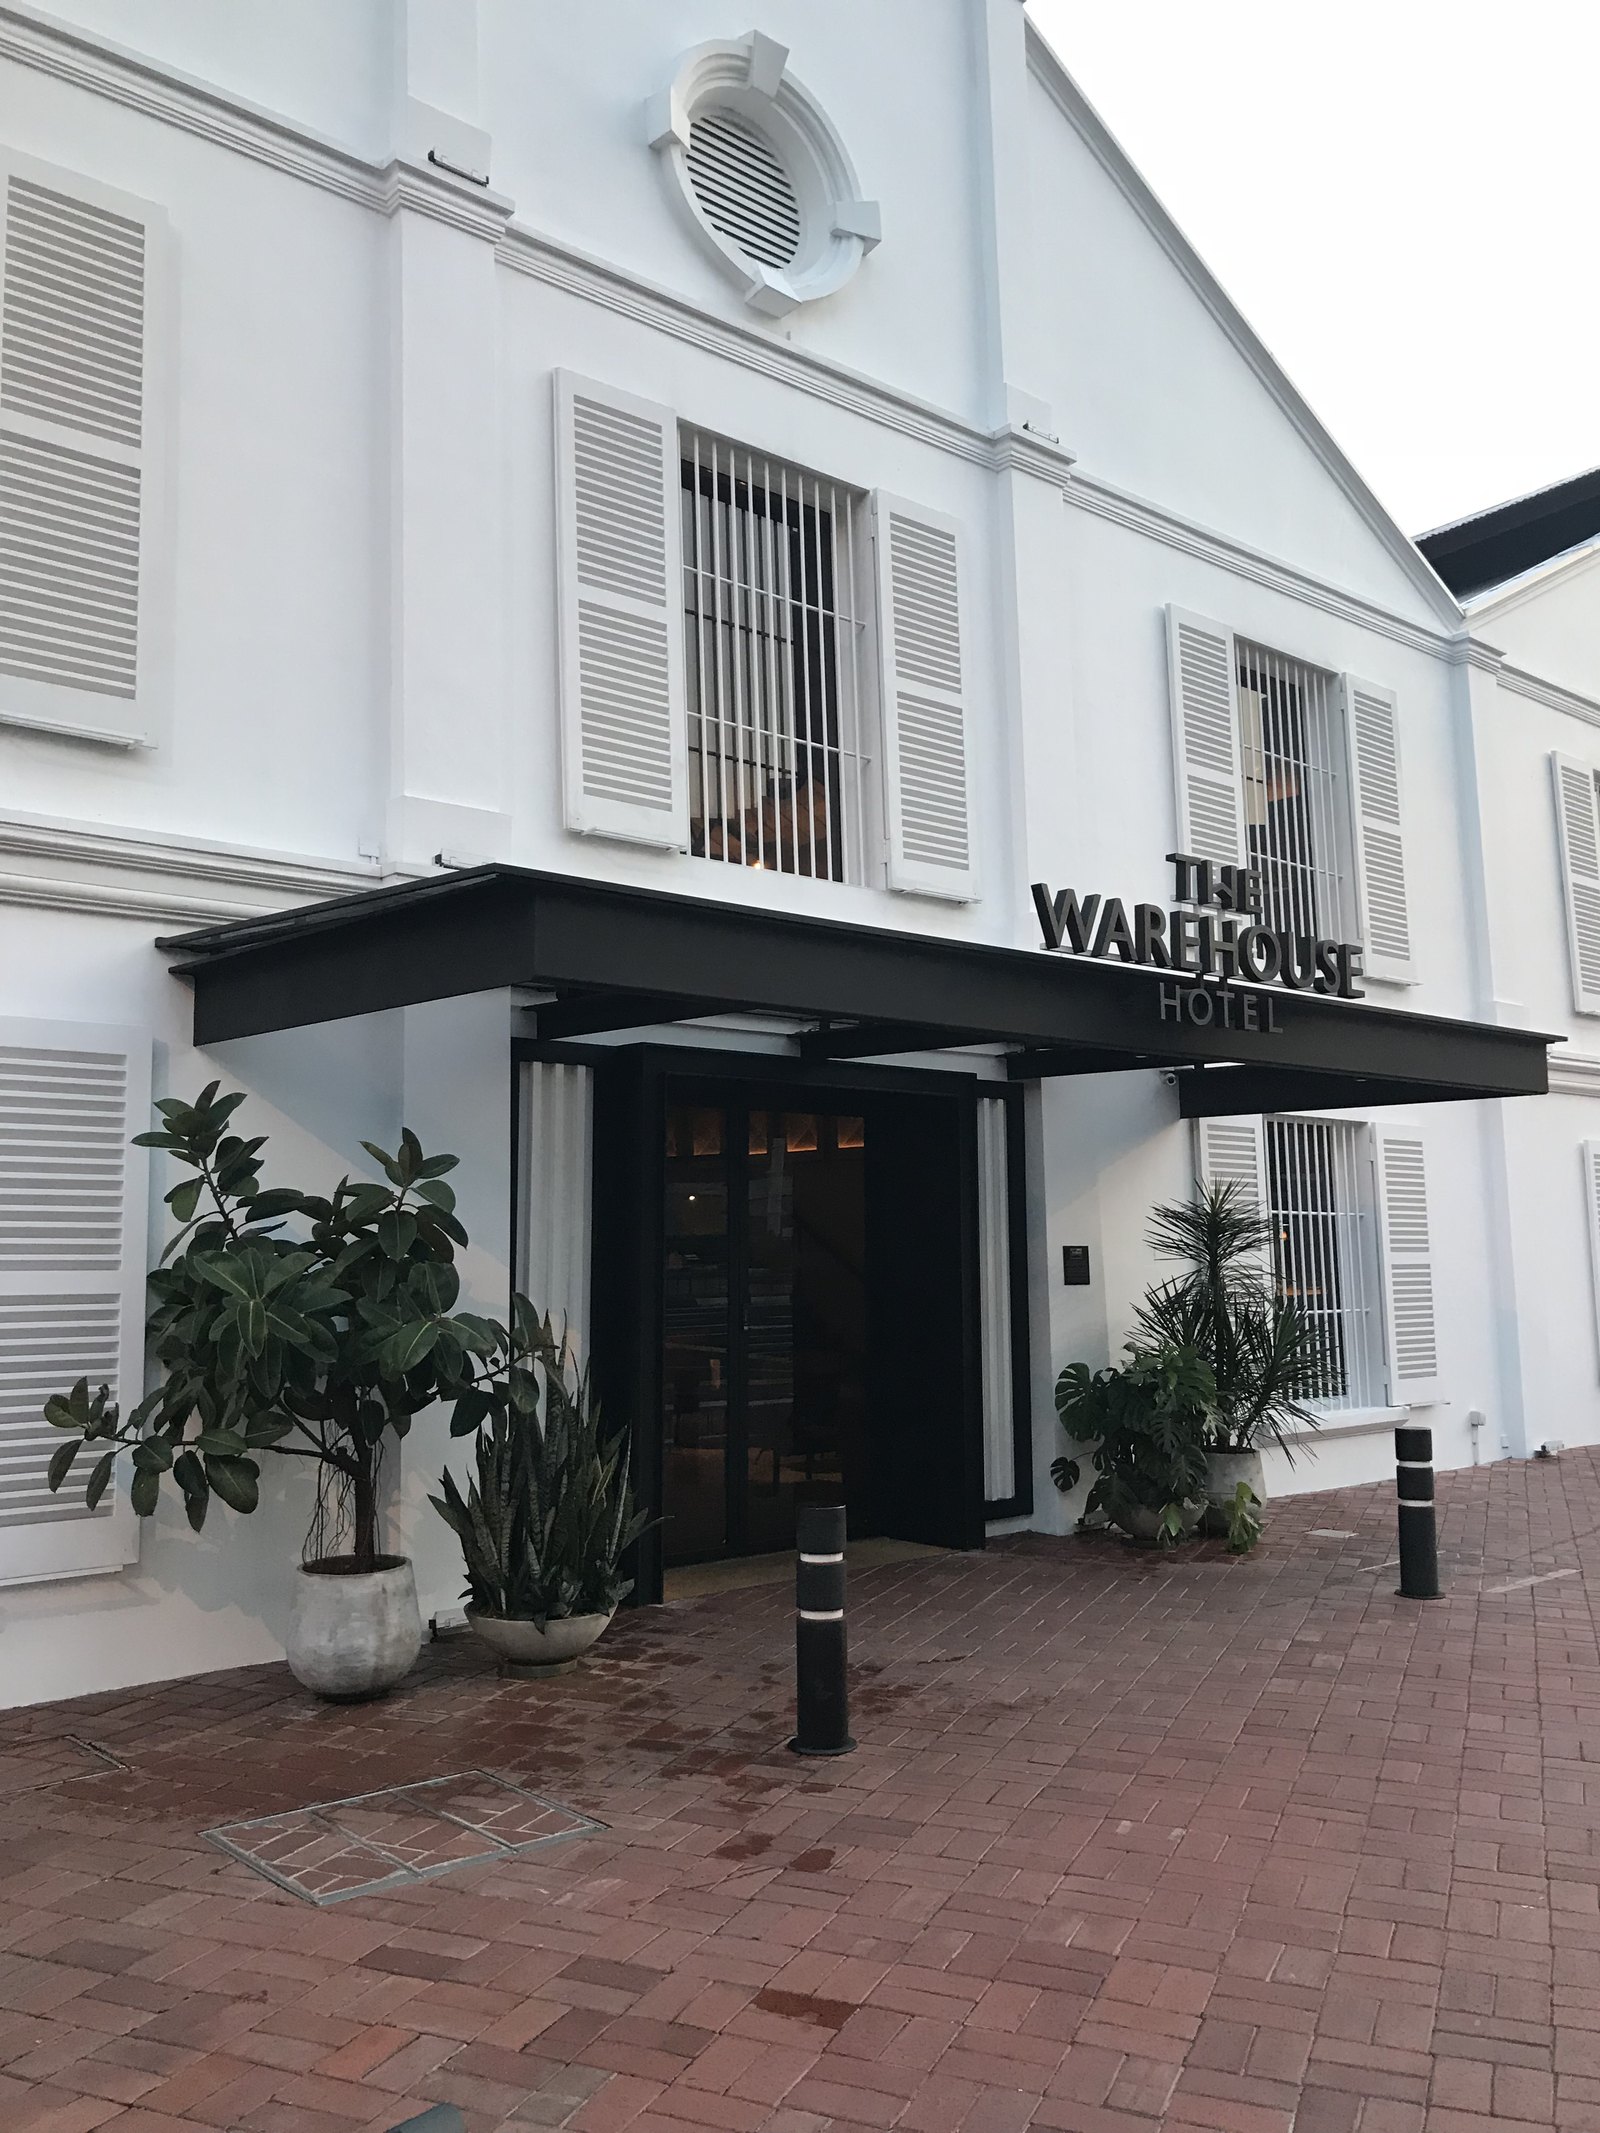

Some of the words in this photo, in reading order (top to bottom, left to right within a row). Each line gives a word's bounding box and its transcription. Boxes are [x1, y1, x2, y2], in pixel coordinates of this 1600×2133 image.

[1166, 853, 1261, 914] THE
[1031, 883, 1365, 998] WAREHOUSE
[1160, 982, 1283, 1033] HOTEL
